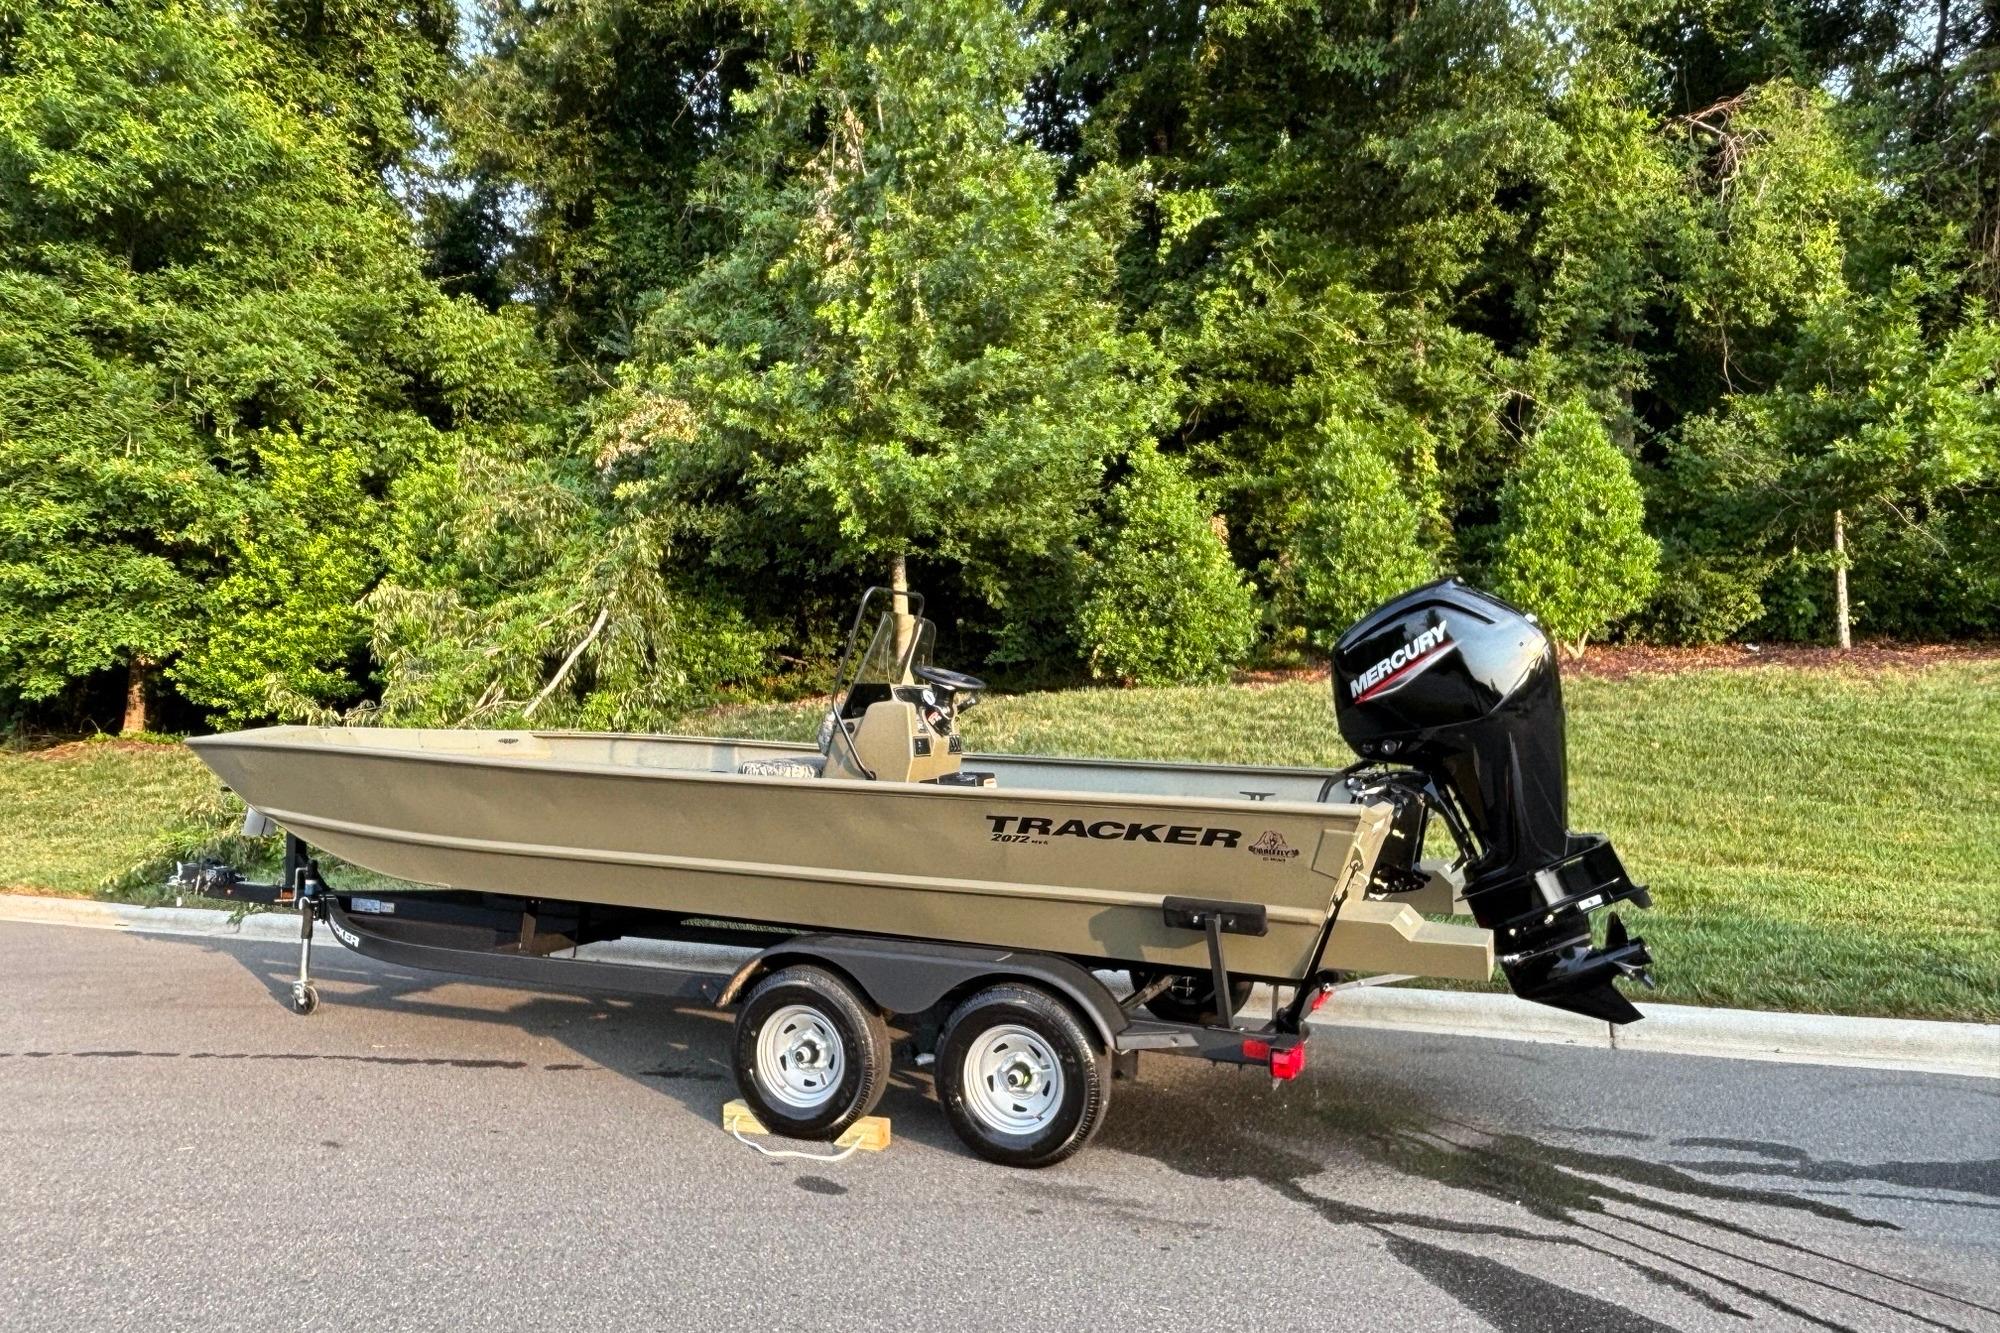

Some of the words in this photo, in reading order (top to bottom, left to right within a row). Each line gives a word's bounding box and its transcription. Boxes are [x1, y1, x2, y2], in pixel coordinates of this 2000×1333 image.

[1350, 620, 1447, 698] MERCURY
[986, 815, 1242, 848] TRACKER
[991, 833, 1030, 844] 2072
